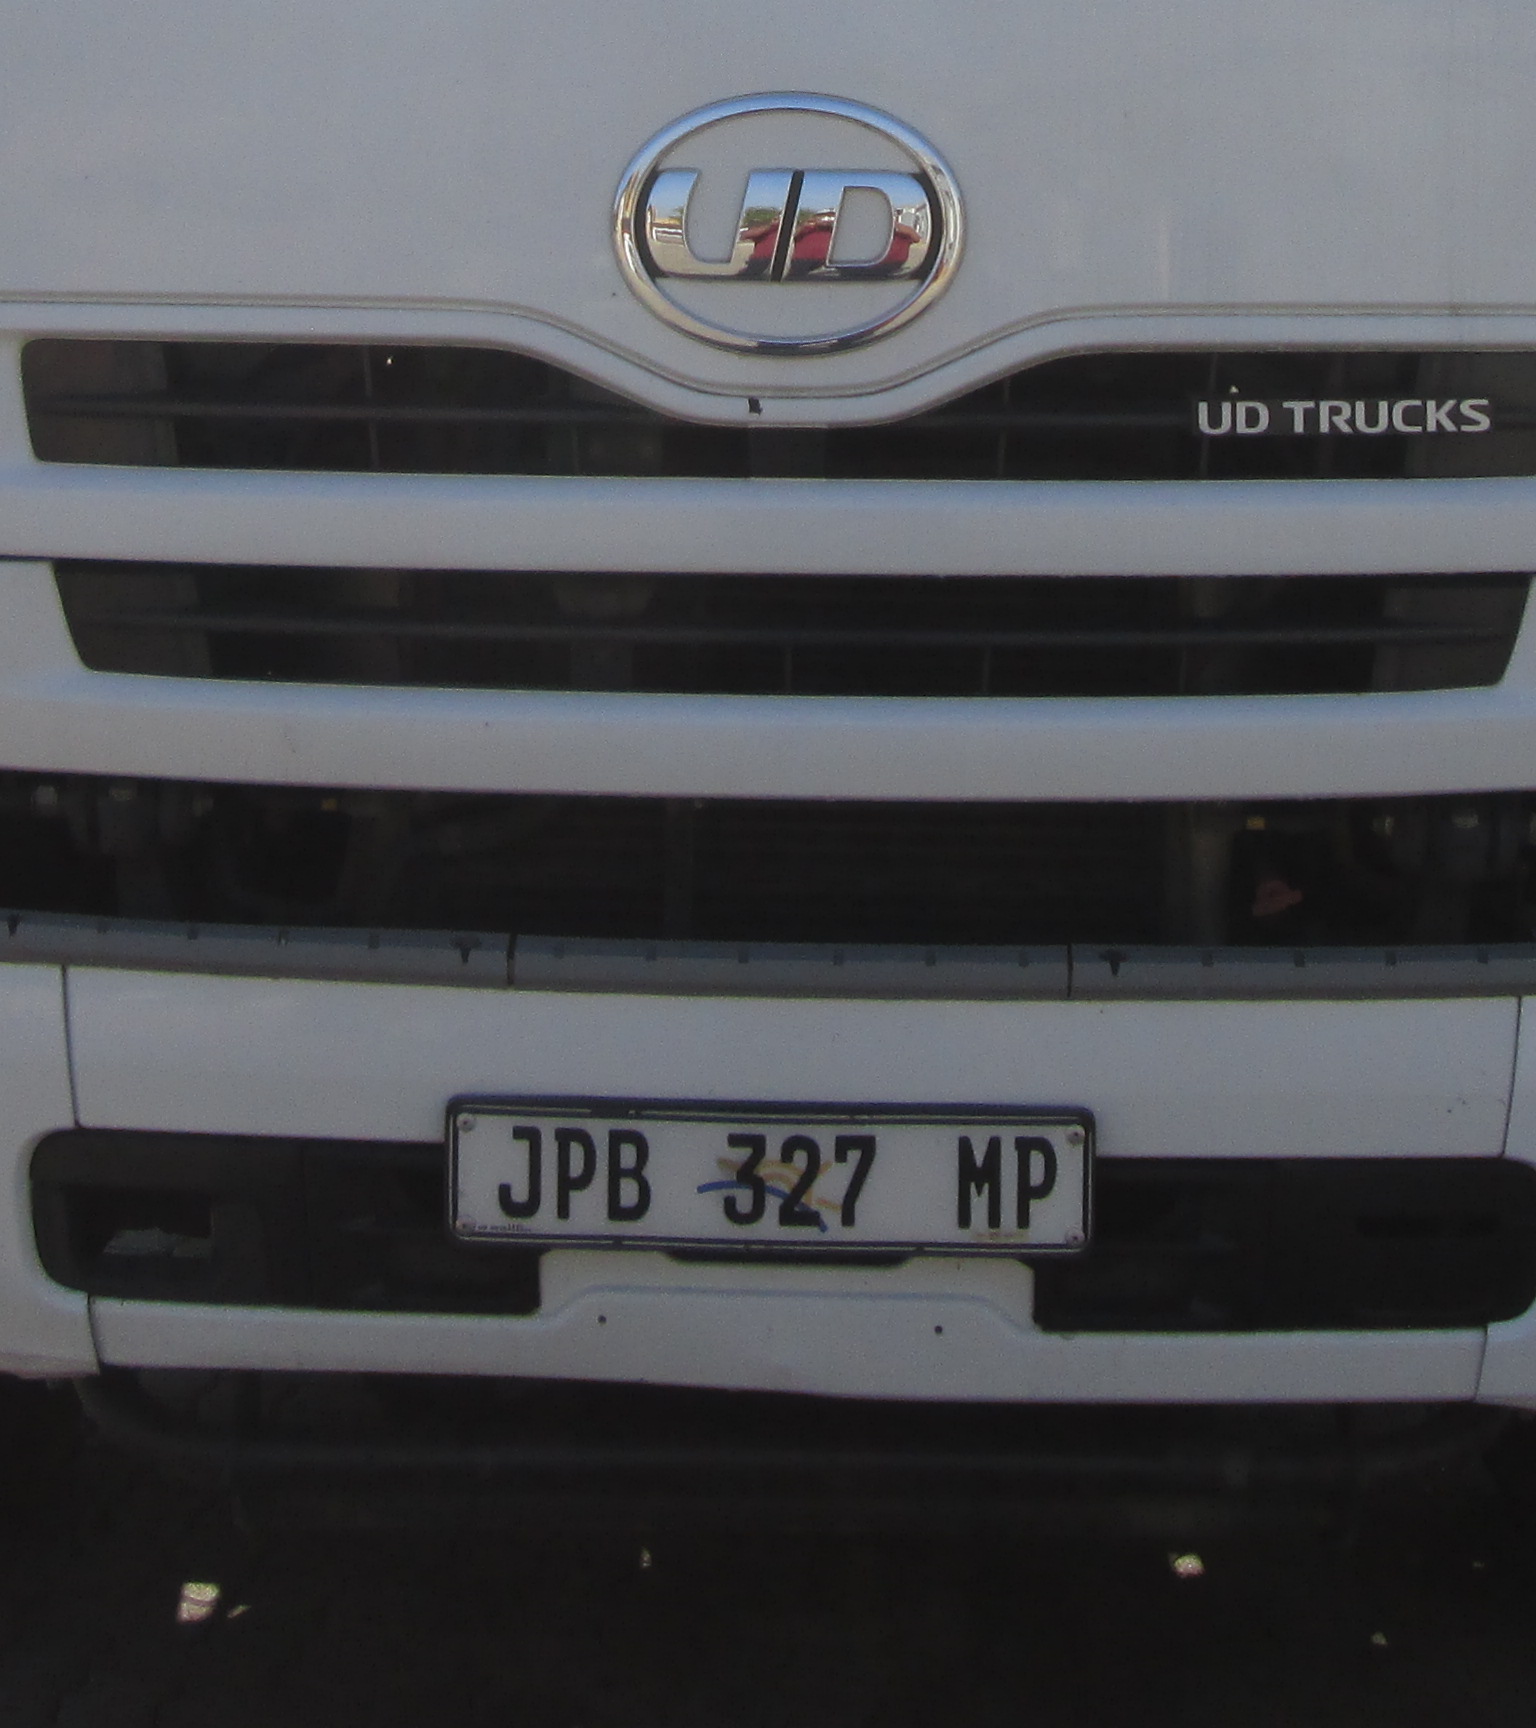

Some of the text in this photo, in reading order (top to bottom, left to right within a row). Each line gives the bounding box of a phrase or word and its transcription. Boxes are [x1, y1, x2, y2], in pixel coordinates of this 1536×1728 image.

[645, 169, 931, 280] UD
[1197, 399, 1491, 434] UD TRUCKS
[498, 1125, 1058, 1229] JPB 327 MP
